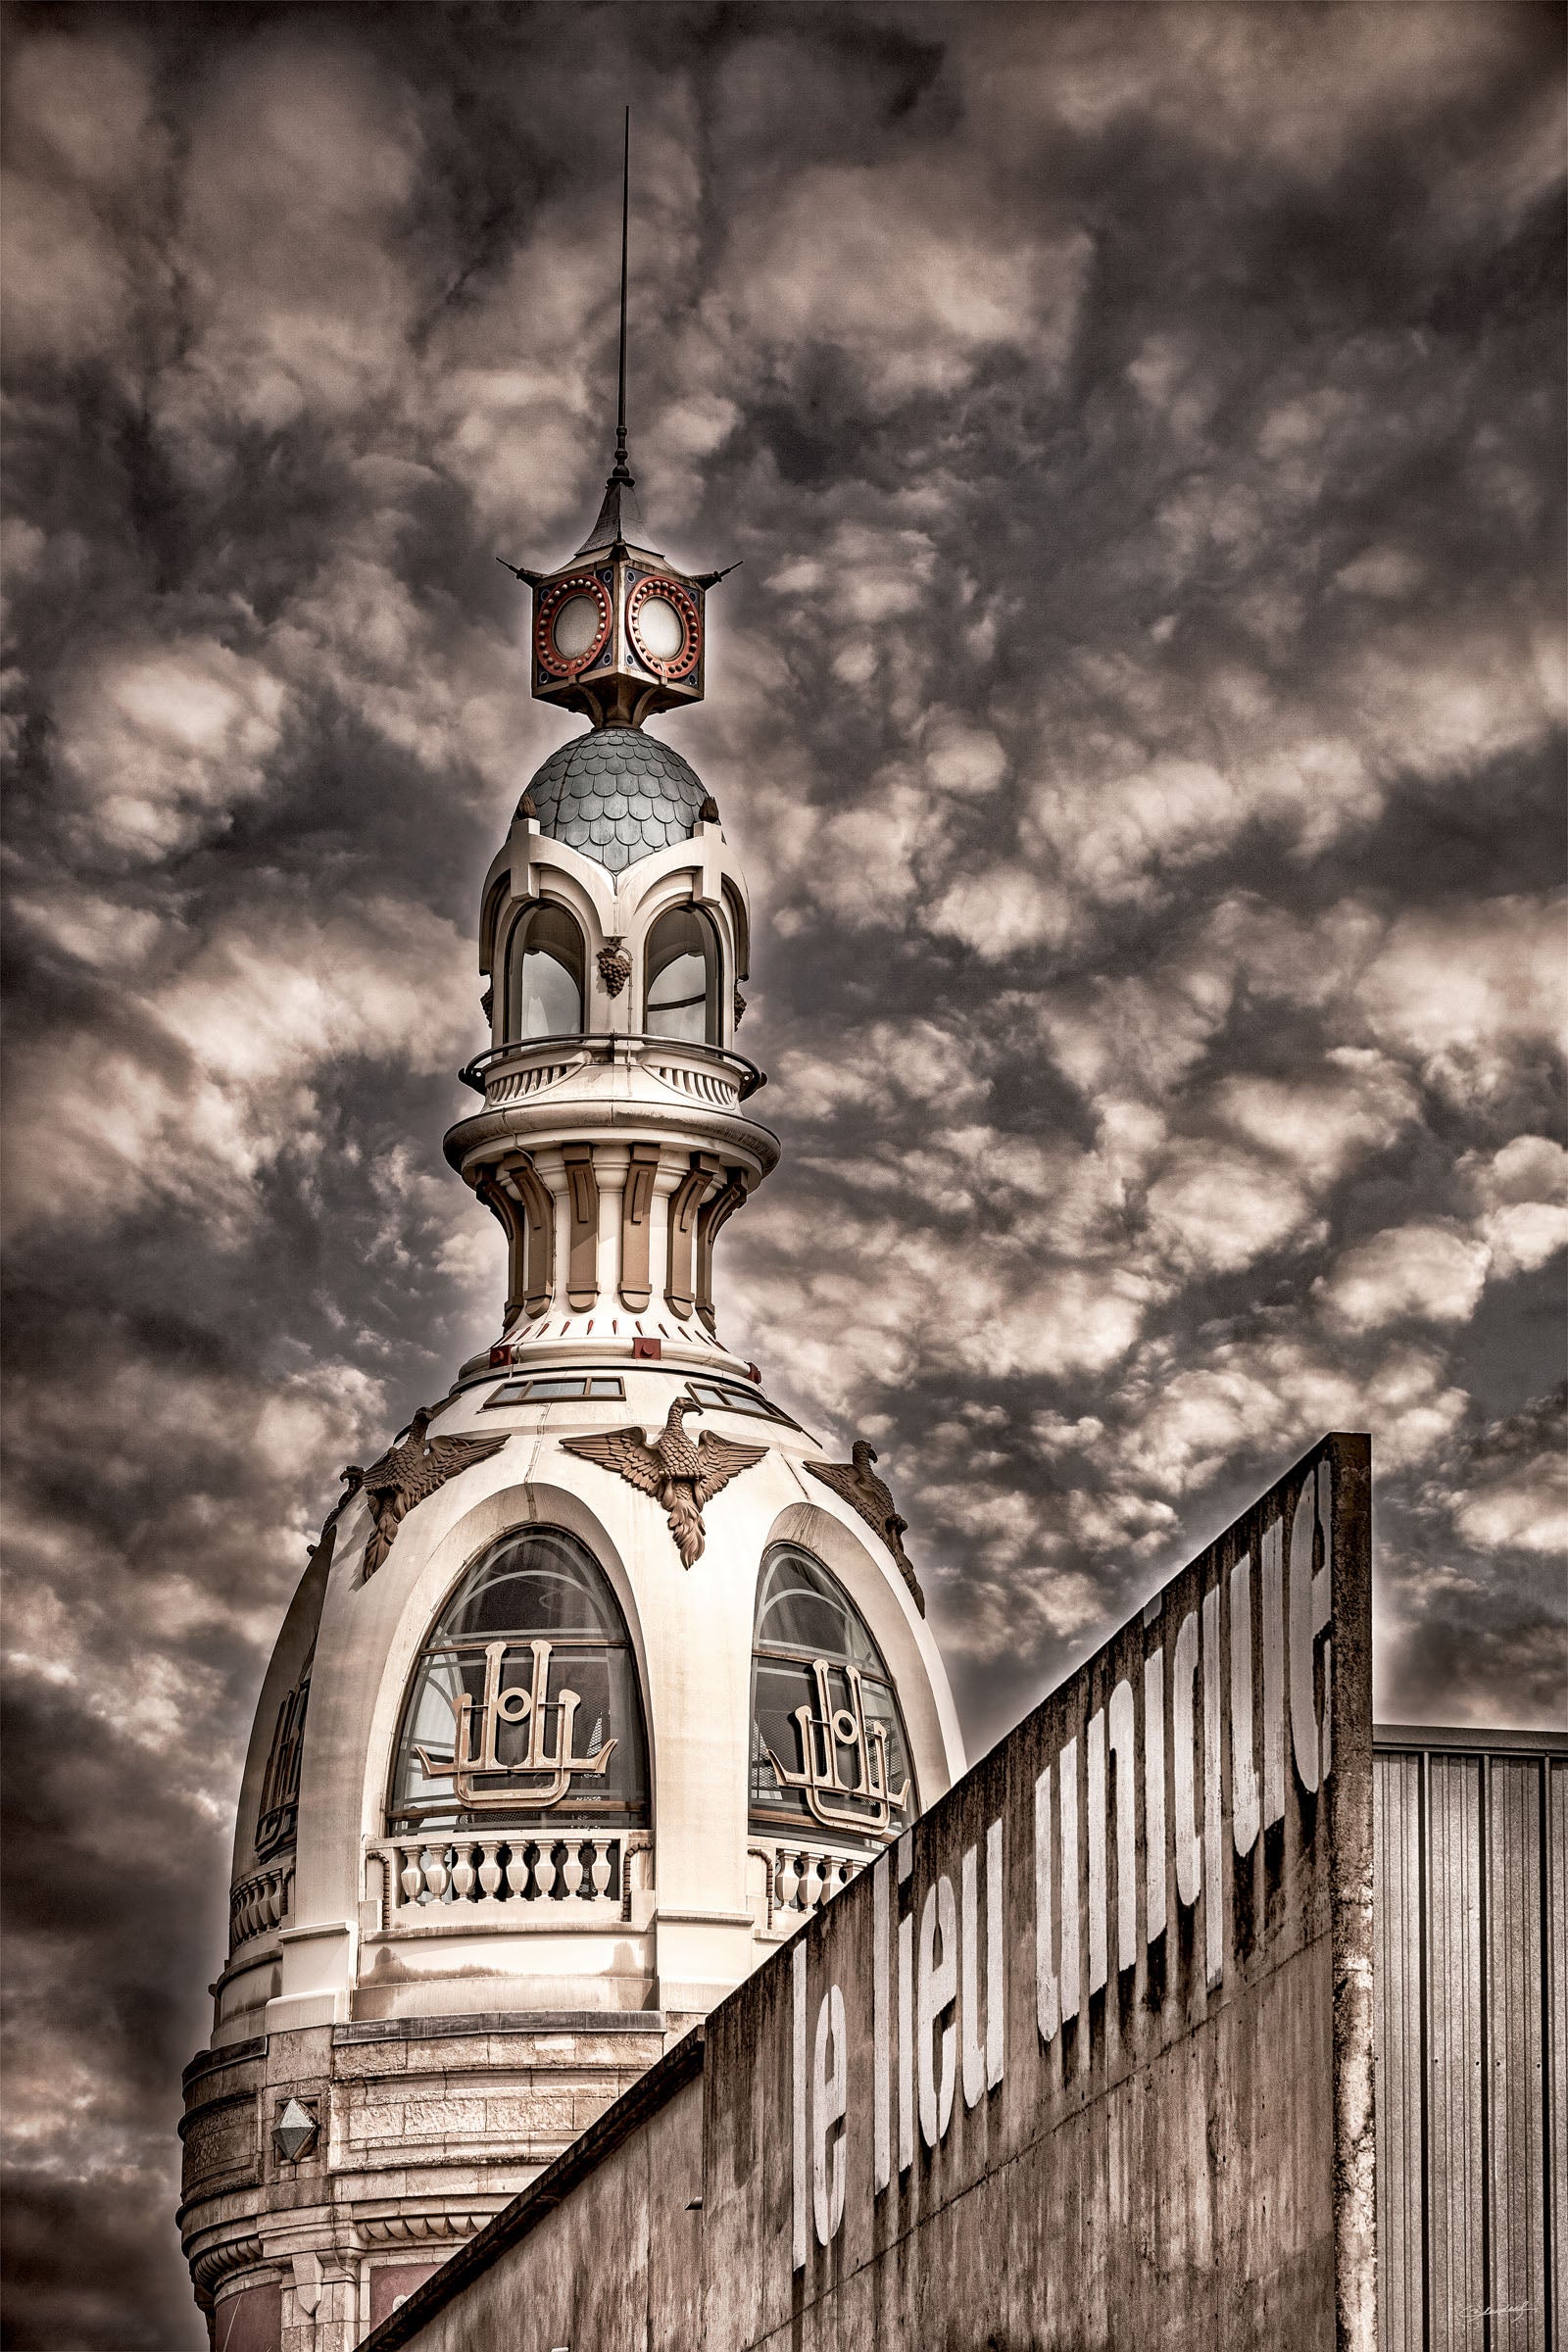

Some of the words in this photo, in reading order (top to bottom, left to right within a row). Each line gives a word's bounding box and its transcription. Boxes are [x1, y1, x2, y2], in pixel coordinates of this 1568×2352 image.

[793, 1938, 847, 2272] le
[874, 1817, 1004, 2196] lieu
[1035, 1458, 1332, 2041] unique
